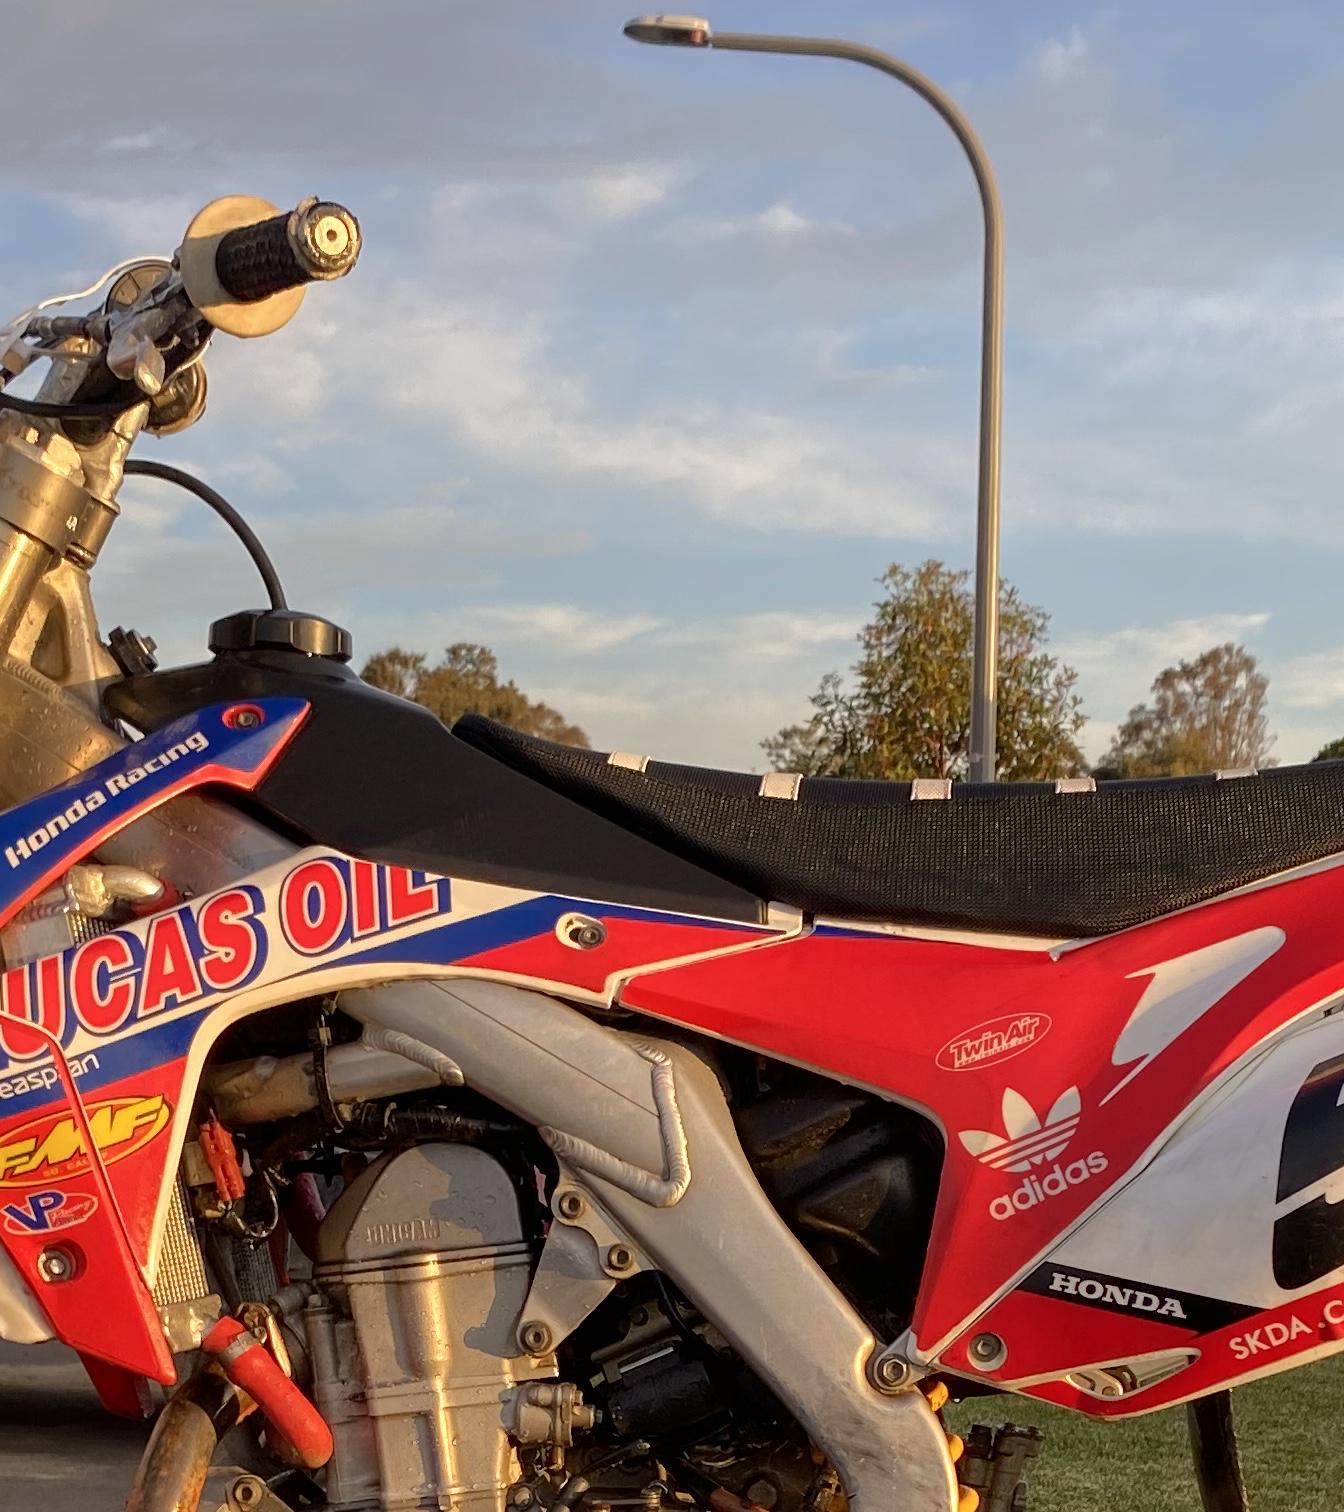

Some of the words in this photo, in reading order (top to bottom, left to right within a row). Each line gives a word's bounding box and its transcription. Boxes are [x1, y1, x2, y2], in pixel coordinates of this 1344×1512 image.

[5, 789, 107, 869] Honda
[105, 732, 209, 796] Racing
[279, 857, 451, 958] OIL
[950, 1031, 1004, 1063] Twin
[1006, 1016, 1040, 1042] Air
[1, 1190, 67, 1231] VP
[989, 1151, 1108, 1220] adidas
[1048, 1272, 1187, 1319] HONDA
